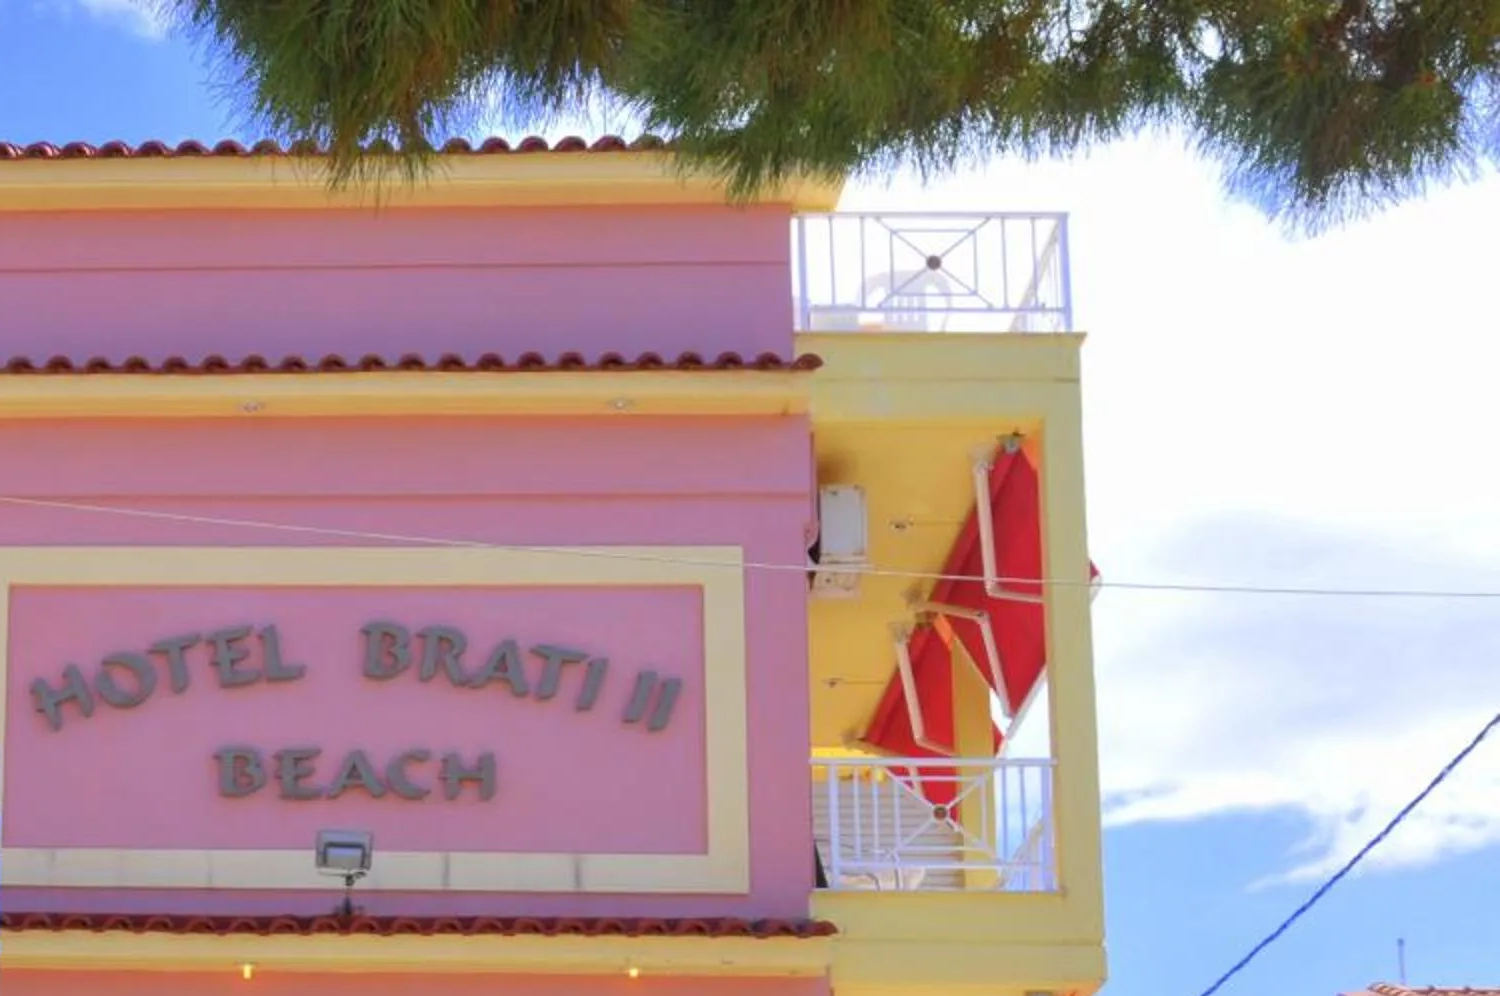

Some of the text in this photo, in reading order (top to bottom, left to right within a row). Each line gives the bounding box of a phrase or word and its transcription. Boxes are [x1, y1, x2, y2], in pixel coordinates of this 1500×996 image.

[30, 620, 682, 732] HOTEL BRATI II
[213, 744, 498, 800] BEACH
